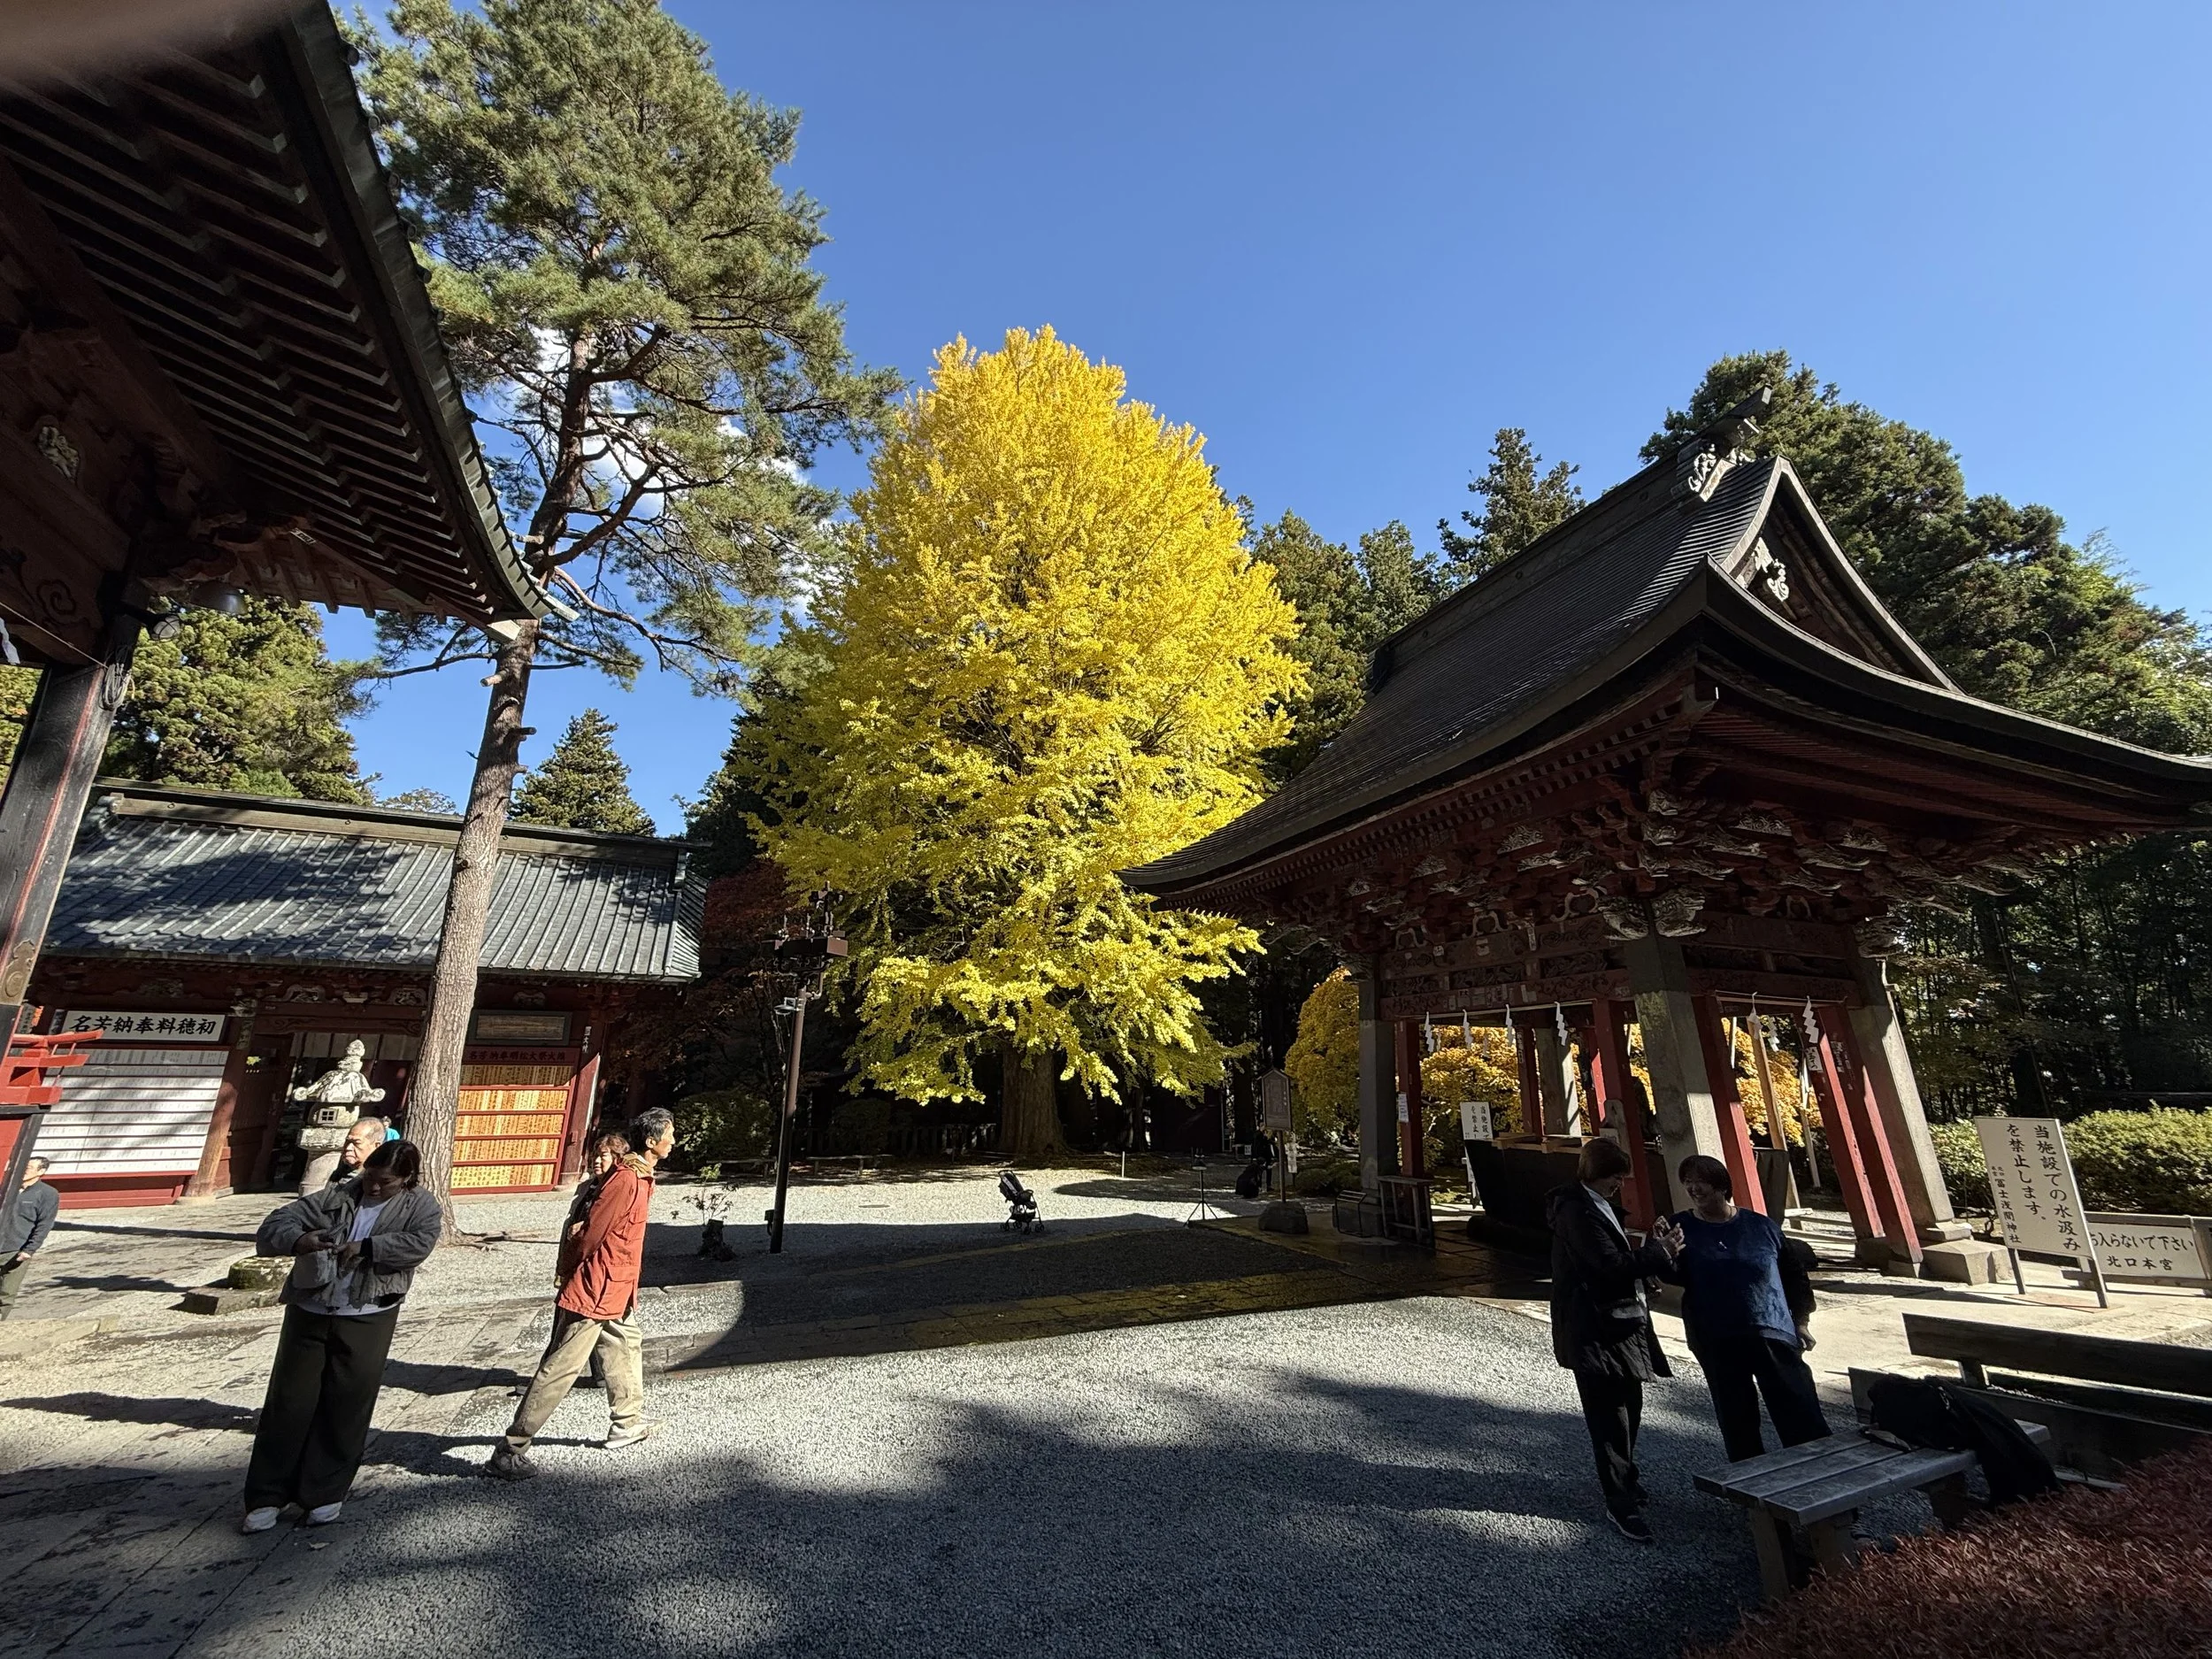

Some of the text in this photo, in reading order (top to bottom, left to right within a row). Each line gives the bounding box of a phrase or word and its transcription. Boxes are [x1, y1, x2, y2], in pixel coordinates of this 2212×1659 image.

[2006, 1123, 2047, 1221] を禁止します。
[2033, 1125, 2081, 1252] 当施設での水汲み
[2106, 1255, 2173, 1271] 北口本宮
